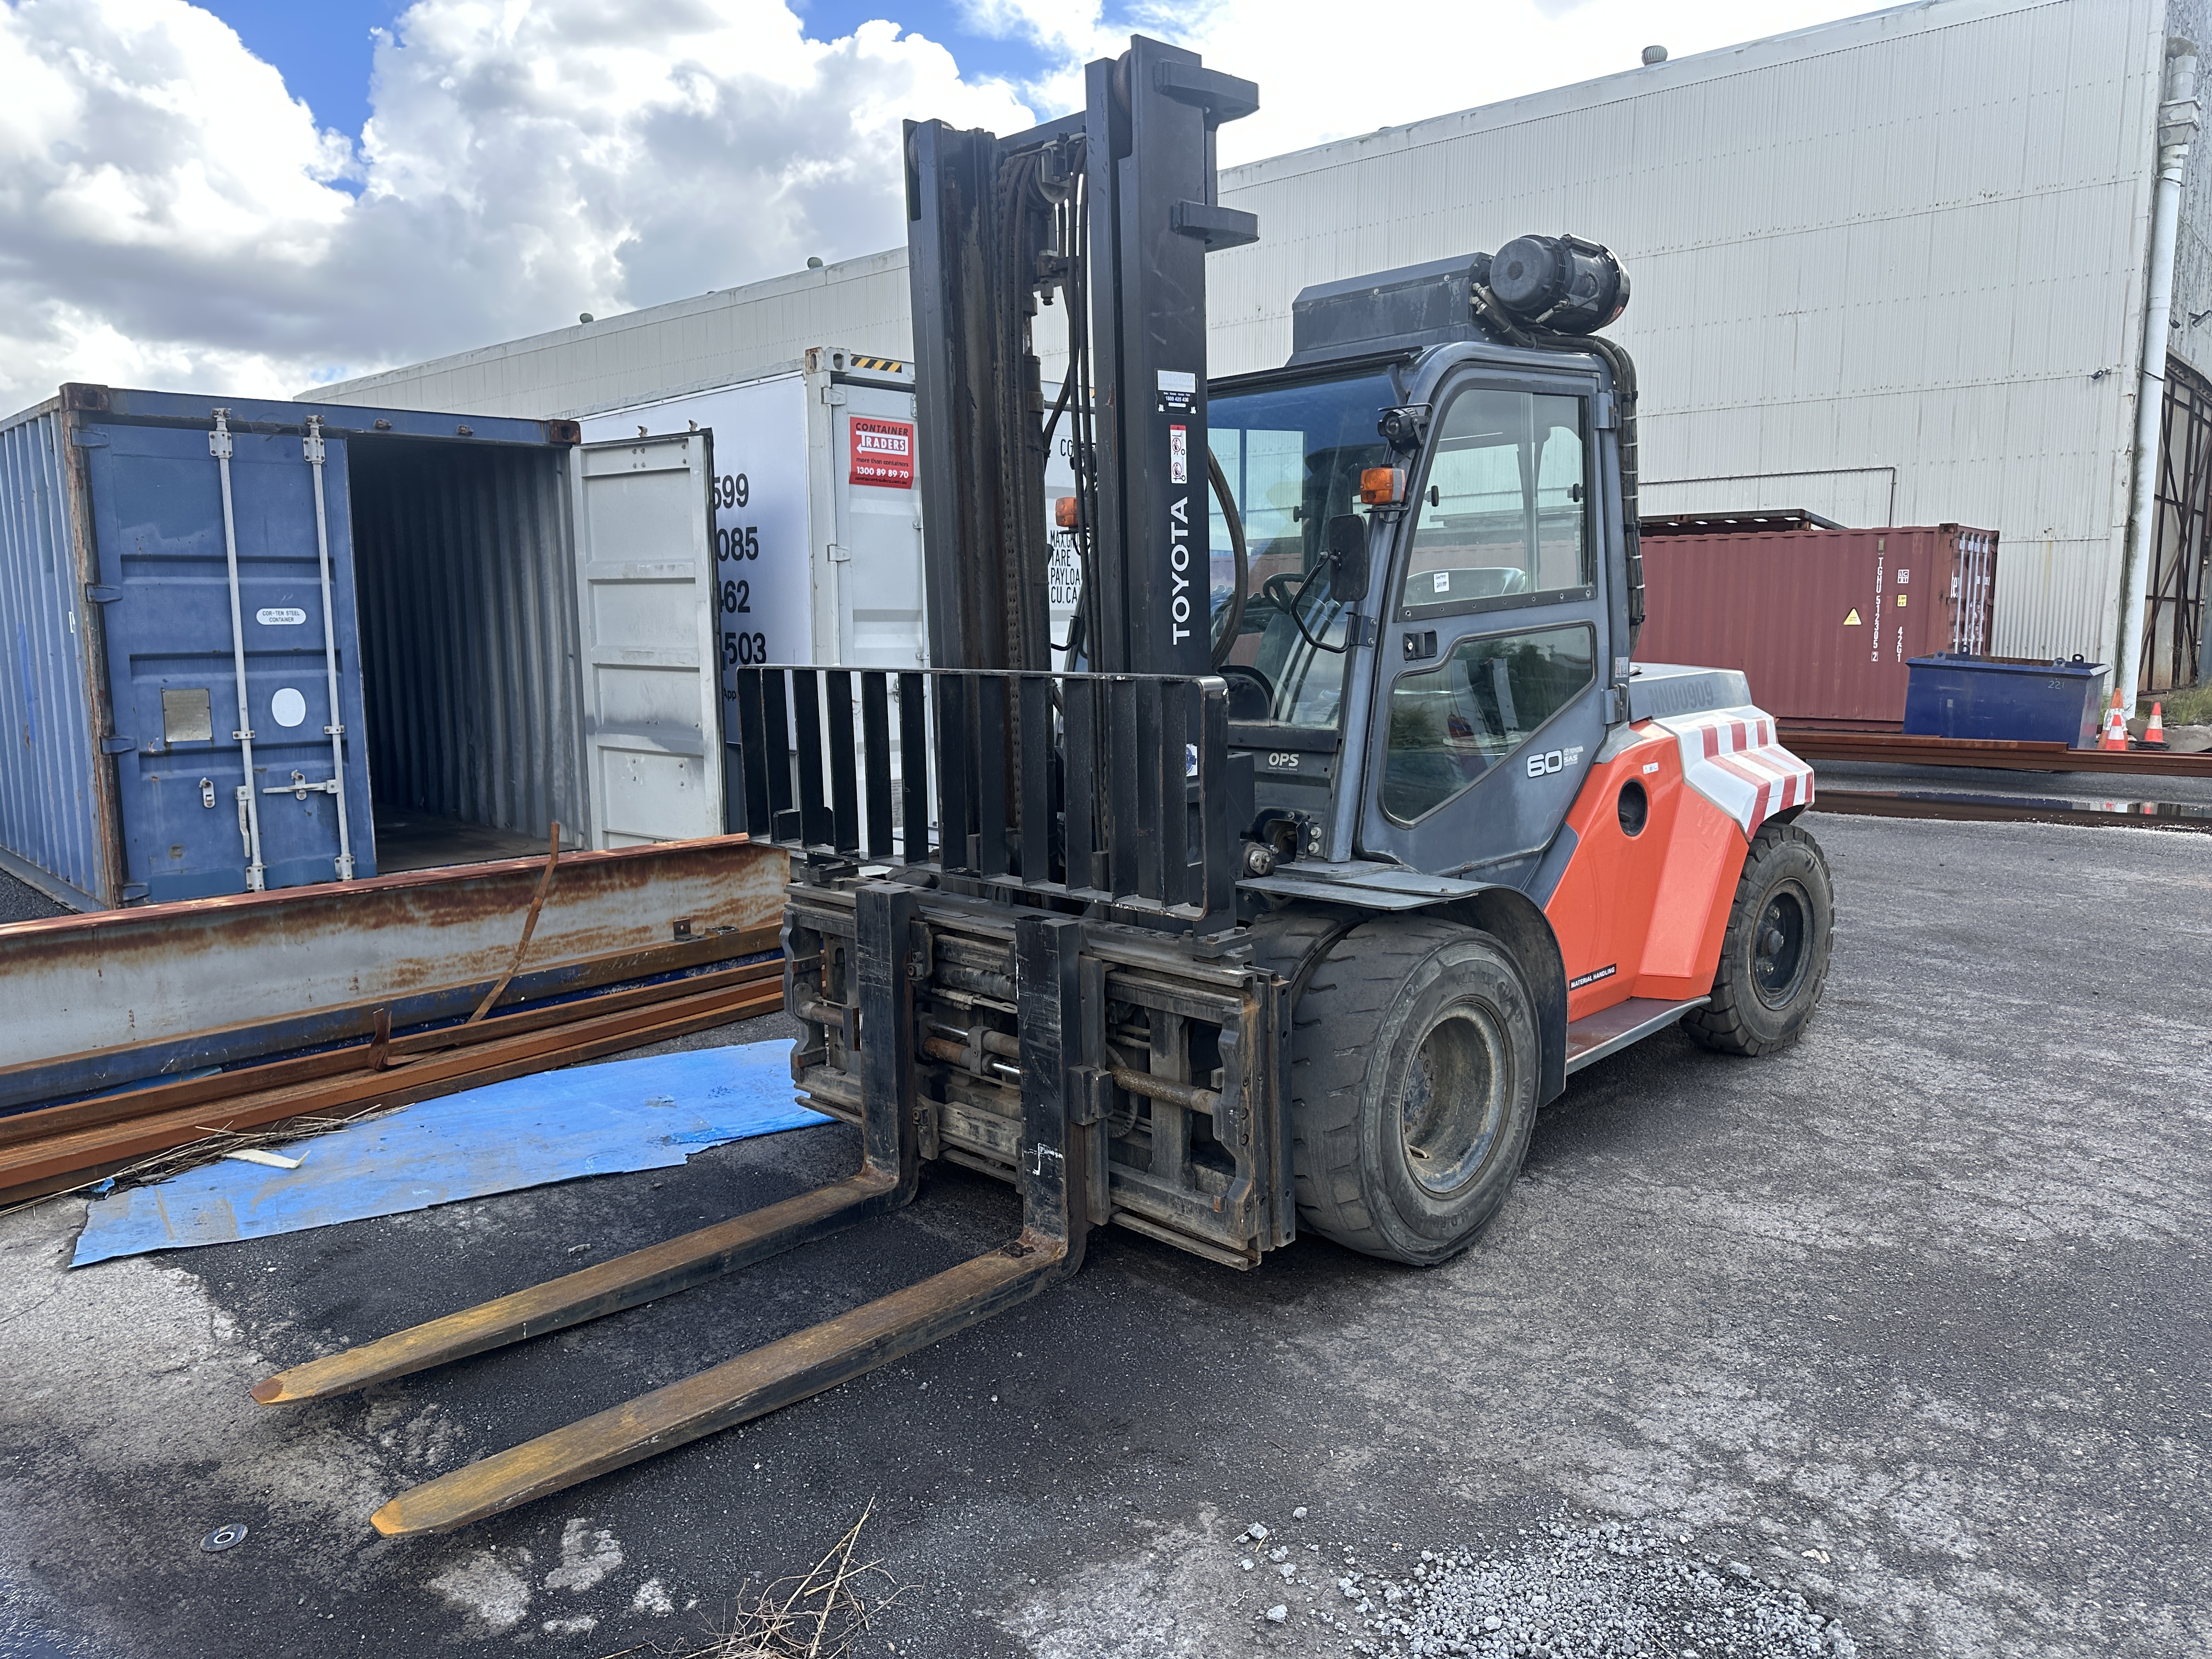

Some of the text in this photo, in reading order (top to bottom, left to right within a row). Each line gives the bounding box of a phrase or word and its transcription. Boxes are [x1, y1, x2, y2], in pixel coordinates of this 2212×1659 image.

[856, 422, 909, 436] CONTAINER
[861, 433, 905, 450] TRADERS
[857, 466, 874, 475] 1300
[877, 468, 886, 476] 89
[716, 527, 759, 562] 085
[1170, 496, 1190, 645] TOYOTA
[719, 580, 751, 613] 62
[1051, 586, 1080, 603] CU.CA
[725, 632, 766, 665] 503
[1647, 680, 1714, 714] NN00909
[1268, 752, 1299, 767] OPS
[1564, 754, 1578, 763] SAS
[1569, 746, 1583, 754] TOYOTA
[1527, 750, 1562, 777] 60
[1571, 967, 1615, 988] MATERIAL HANDLING
